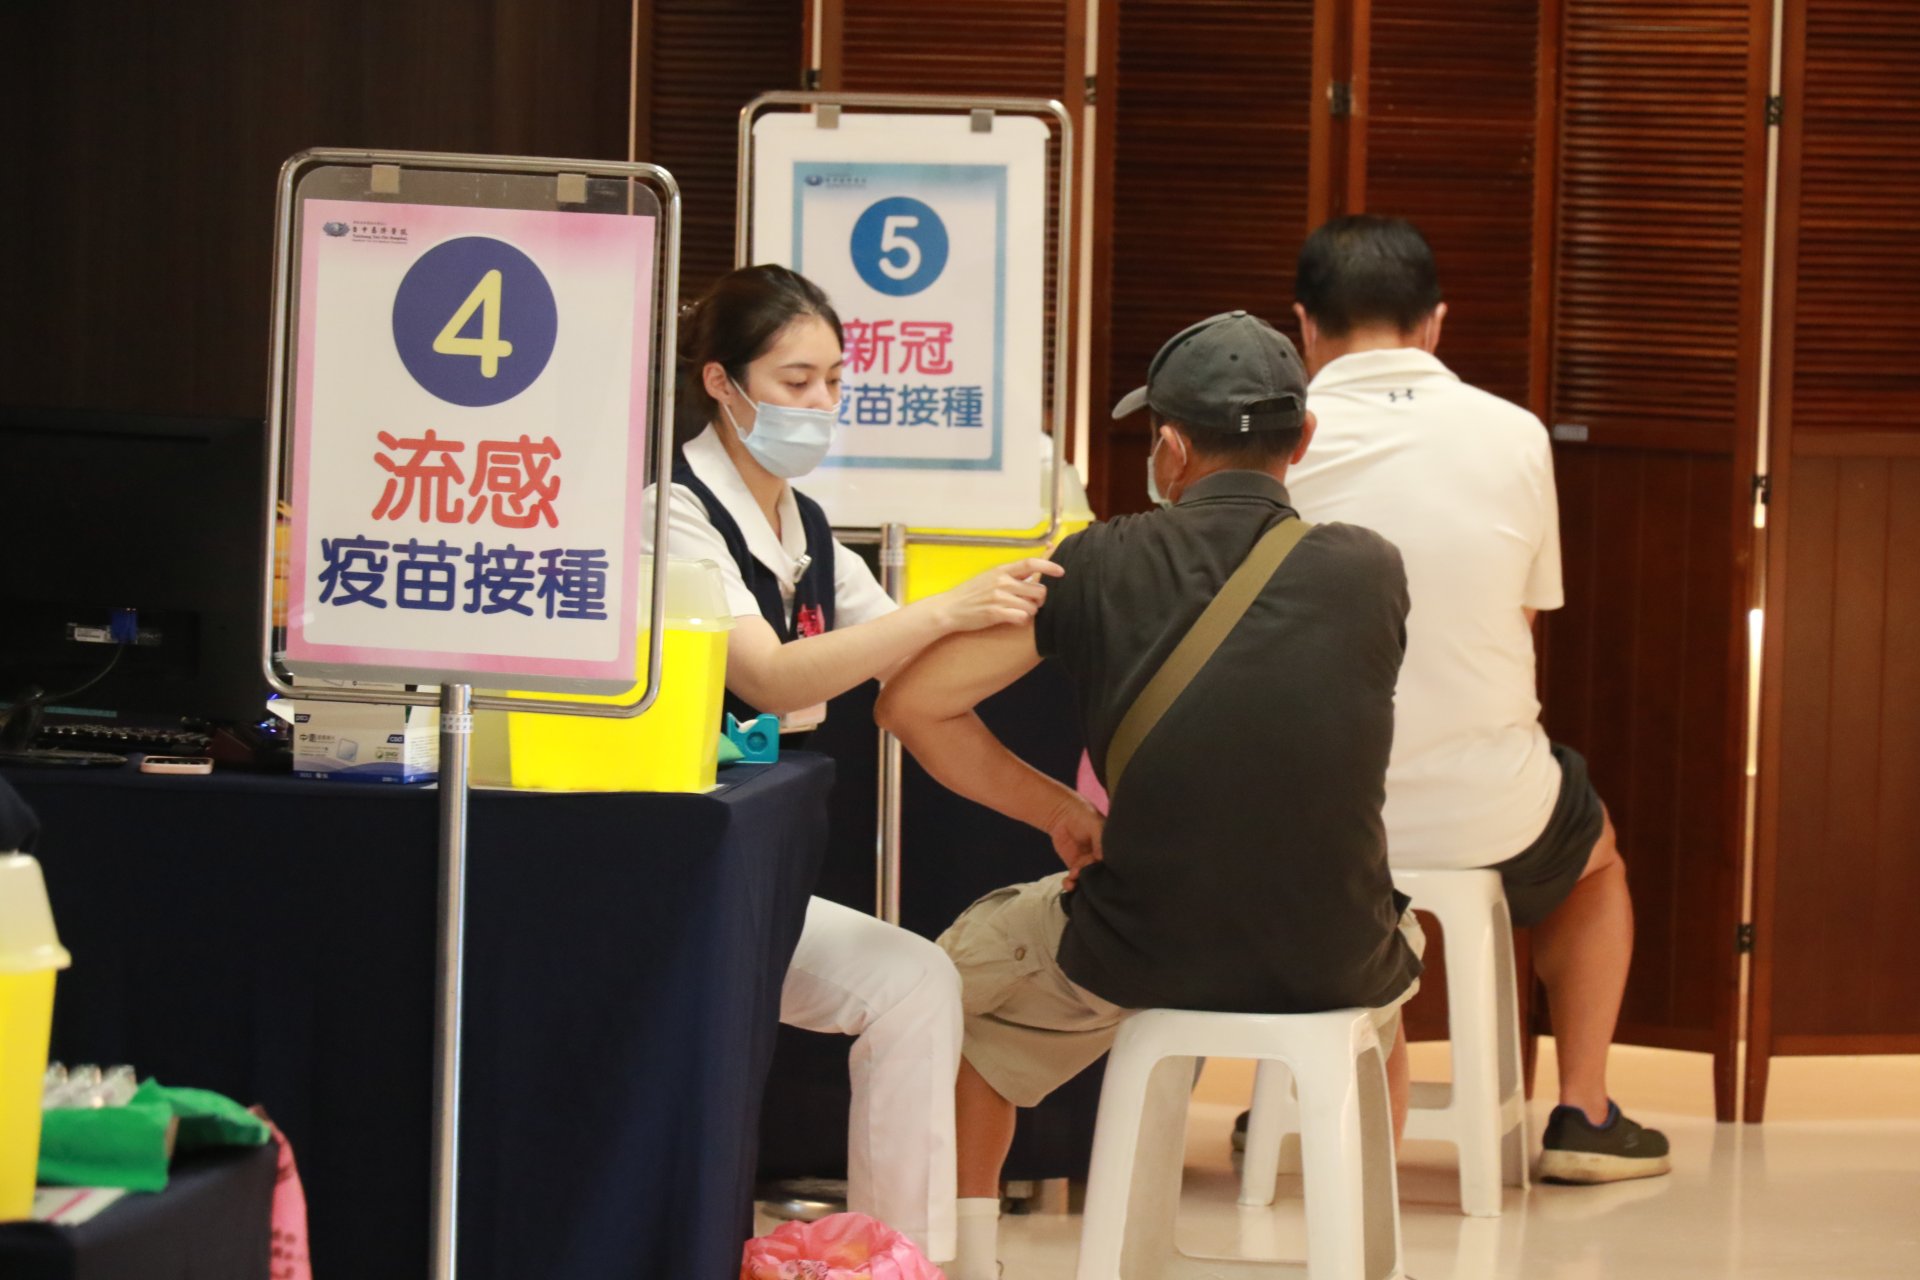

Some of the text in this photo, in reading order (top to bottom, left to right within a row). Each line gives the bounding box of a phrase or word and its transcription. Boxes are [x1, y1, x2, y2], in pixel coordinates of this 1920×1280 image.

[878, 215, 922, 281] 5
[432, 269, 513, 378] 4
[842, 318, 954, 376] 新冠
[838, 383, 984, 428] 苗接種
[371, 429, 561, 529] 流感
[318, 534, 608, 620] 疫苗接種
